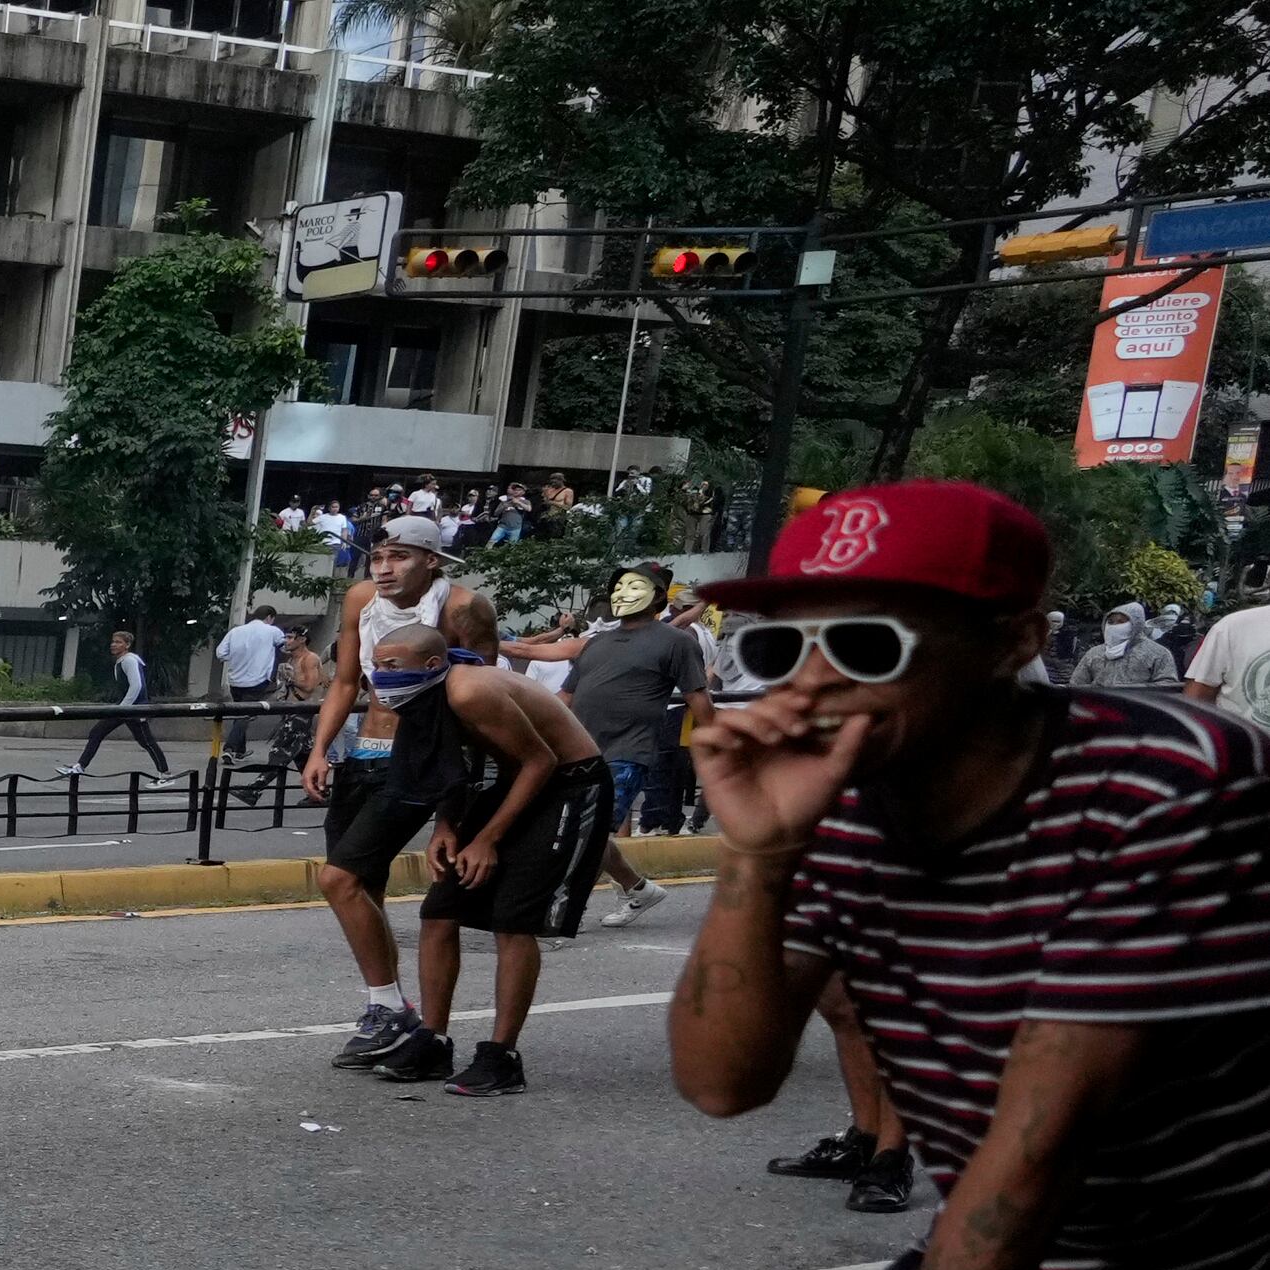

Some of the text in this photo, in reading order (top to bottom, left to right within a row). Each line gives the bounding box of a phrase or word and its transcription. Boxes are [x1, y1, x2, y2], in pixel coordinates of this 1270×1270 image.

[299, 215, 335, 228] MARCO
[306, 225, 333, 236] POLO
[1124, 312, 1193, 325] tu punto
[1120, 324, 1190, 336] de venta
[1125, 339, 1174, 355] aquí
[799, 496, 889, 575] B
[362, 739, 390, 750] Calv
